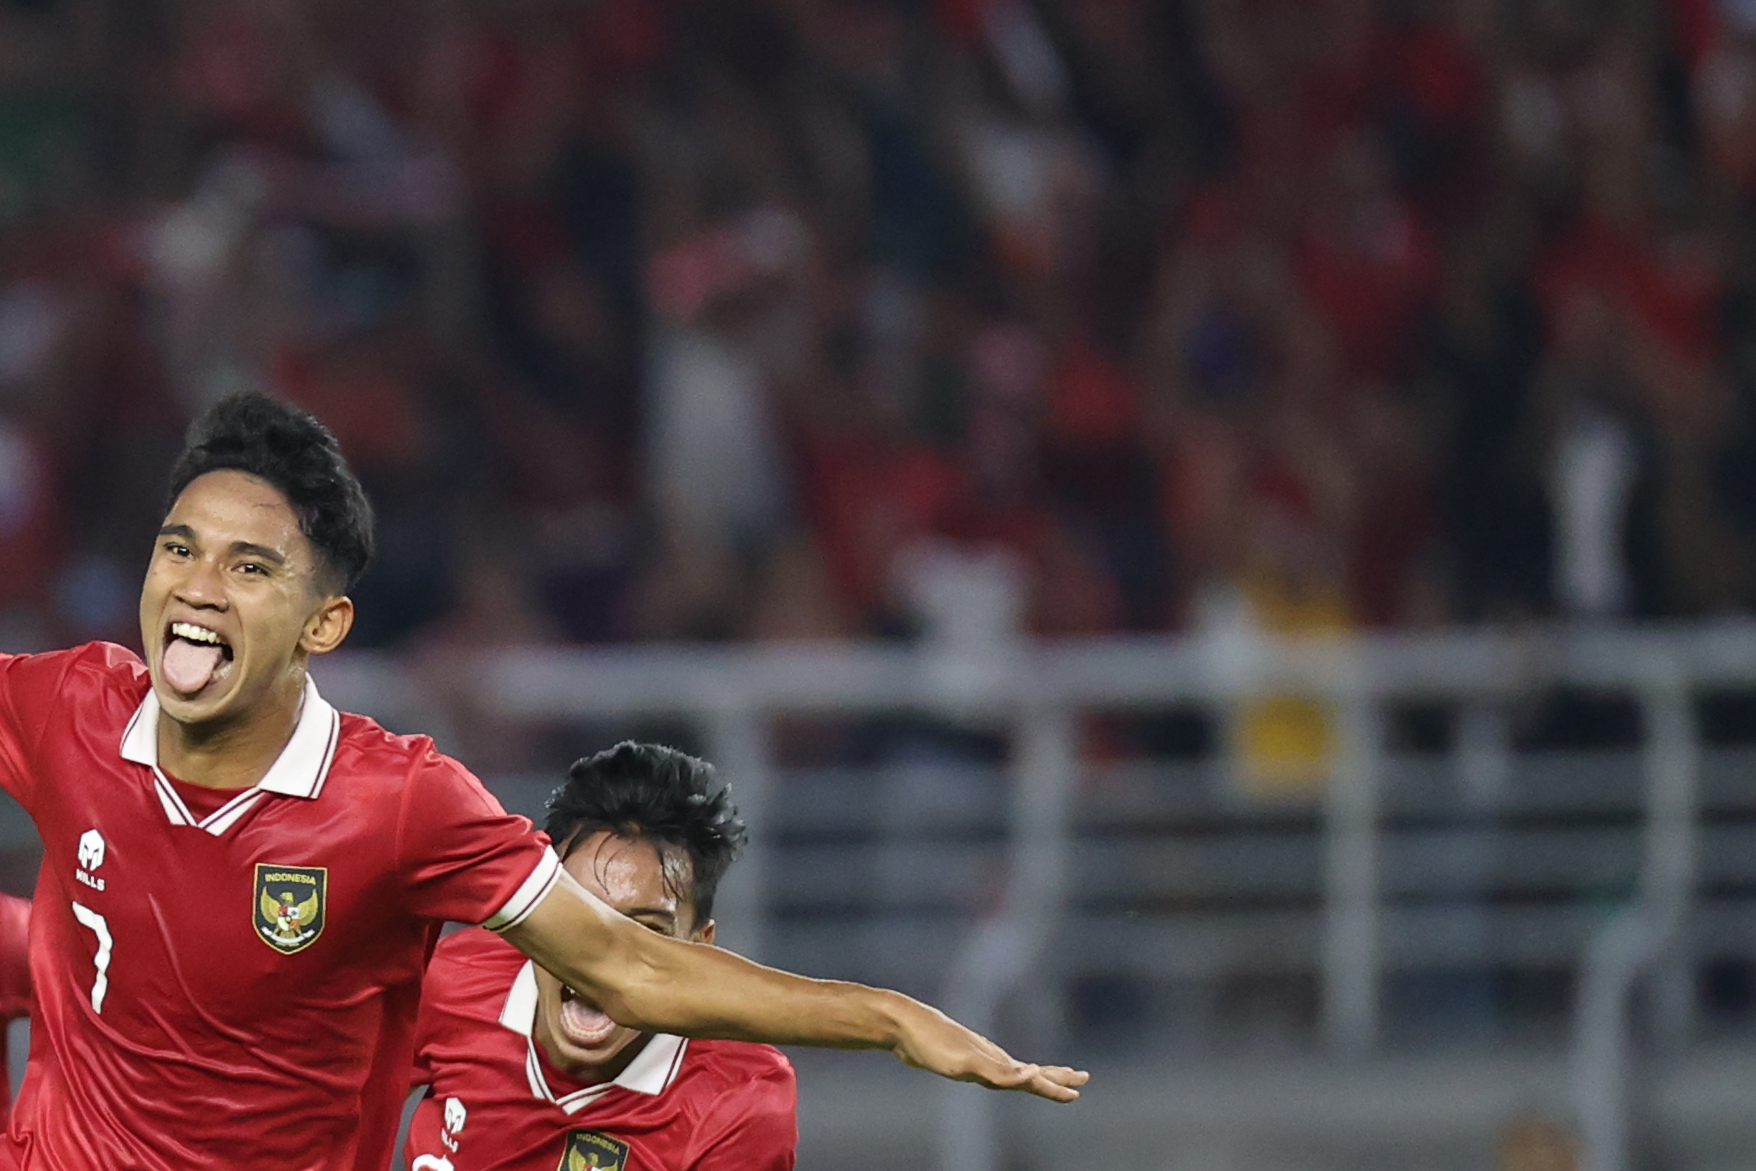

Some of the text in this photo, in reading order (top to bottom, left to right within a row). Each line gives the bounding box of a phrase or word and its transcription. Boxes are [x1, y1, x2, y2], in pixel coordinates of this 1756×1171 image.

[75, 868, 106, 891] MILLS
[265, 872, 316, 885] INDONESIA
[72, 901, 114, 1015] 7
